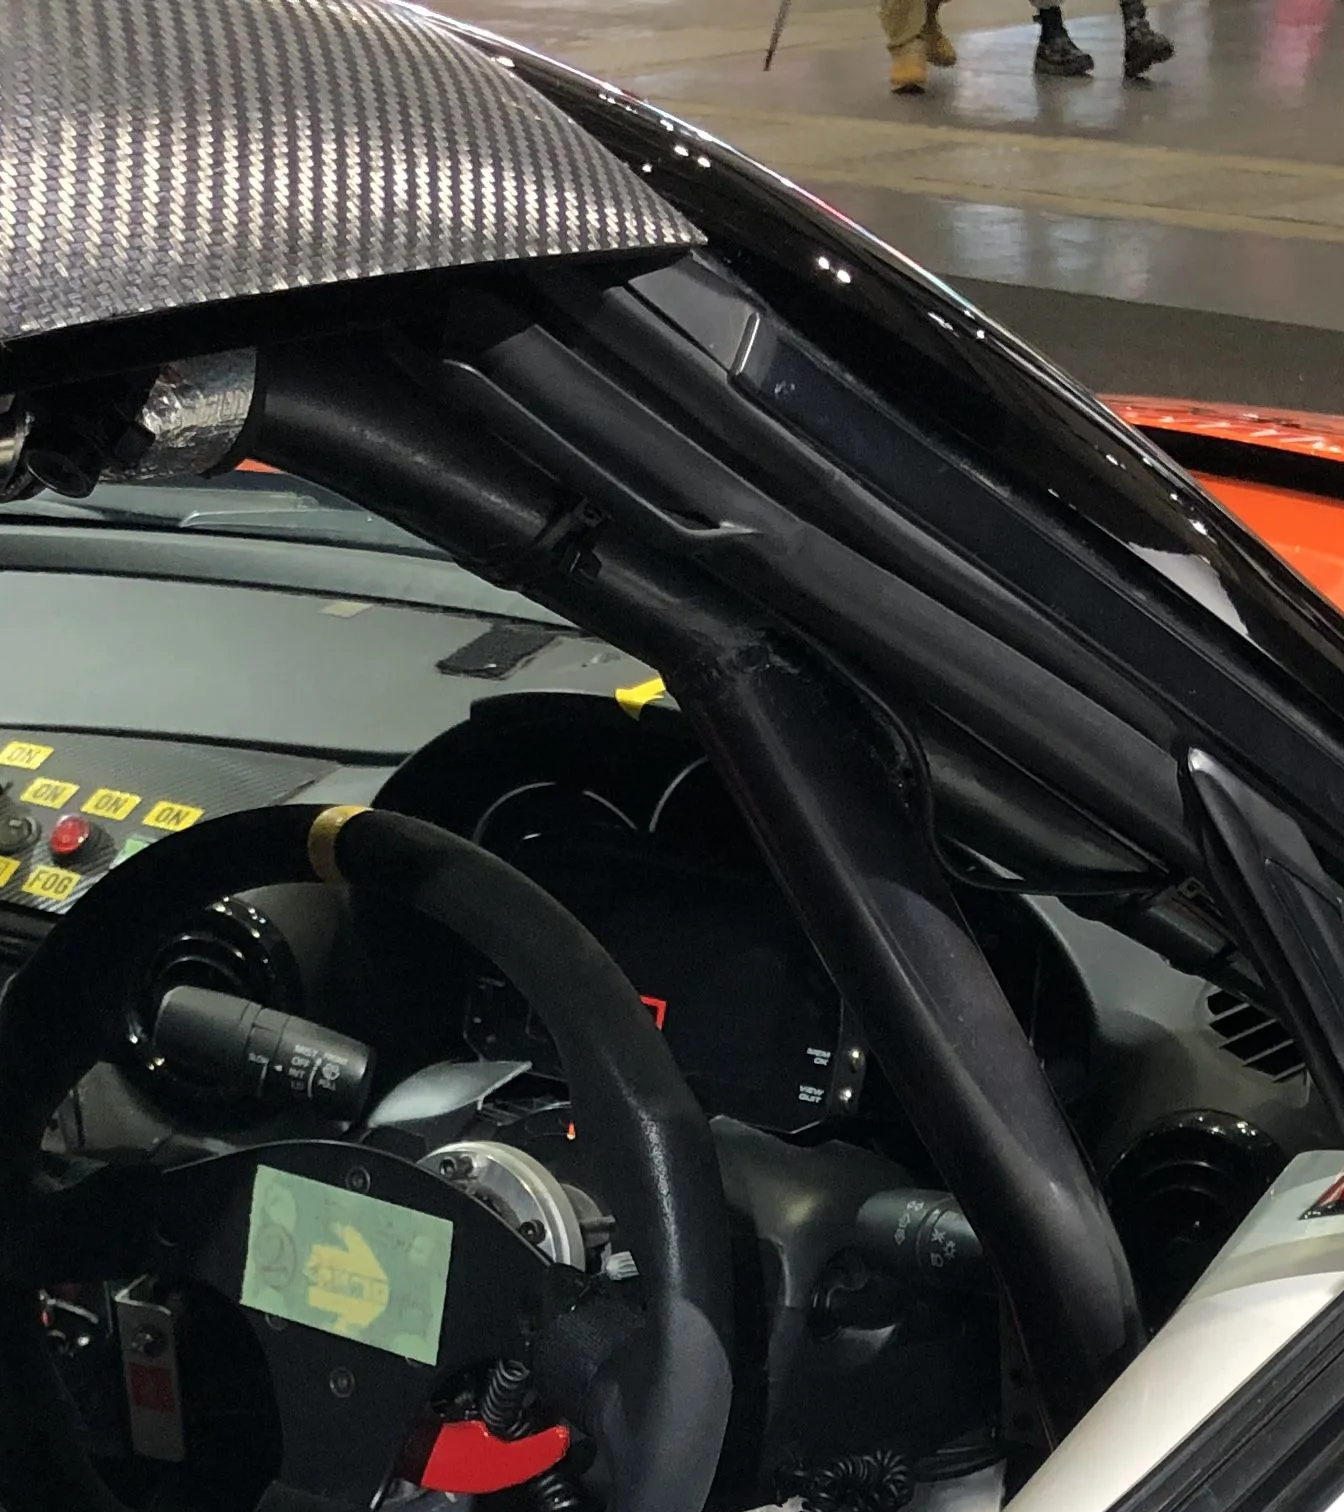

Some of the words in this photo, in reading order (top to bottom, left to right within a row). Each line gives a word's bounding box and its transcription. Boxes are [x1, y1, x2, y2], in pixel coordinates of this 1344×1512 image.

[5, 744, 41, 765] ON
[31, 781, 62, 803] ON
[93, 793, 125, 815] ON
[155, 805, 187, 826] ON
[31, 869, 75, 896] FOG
